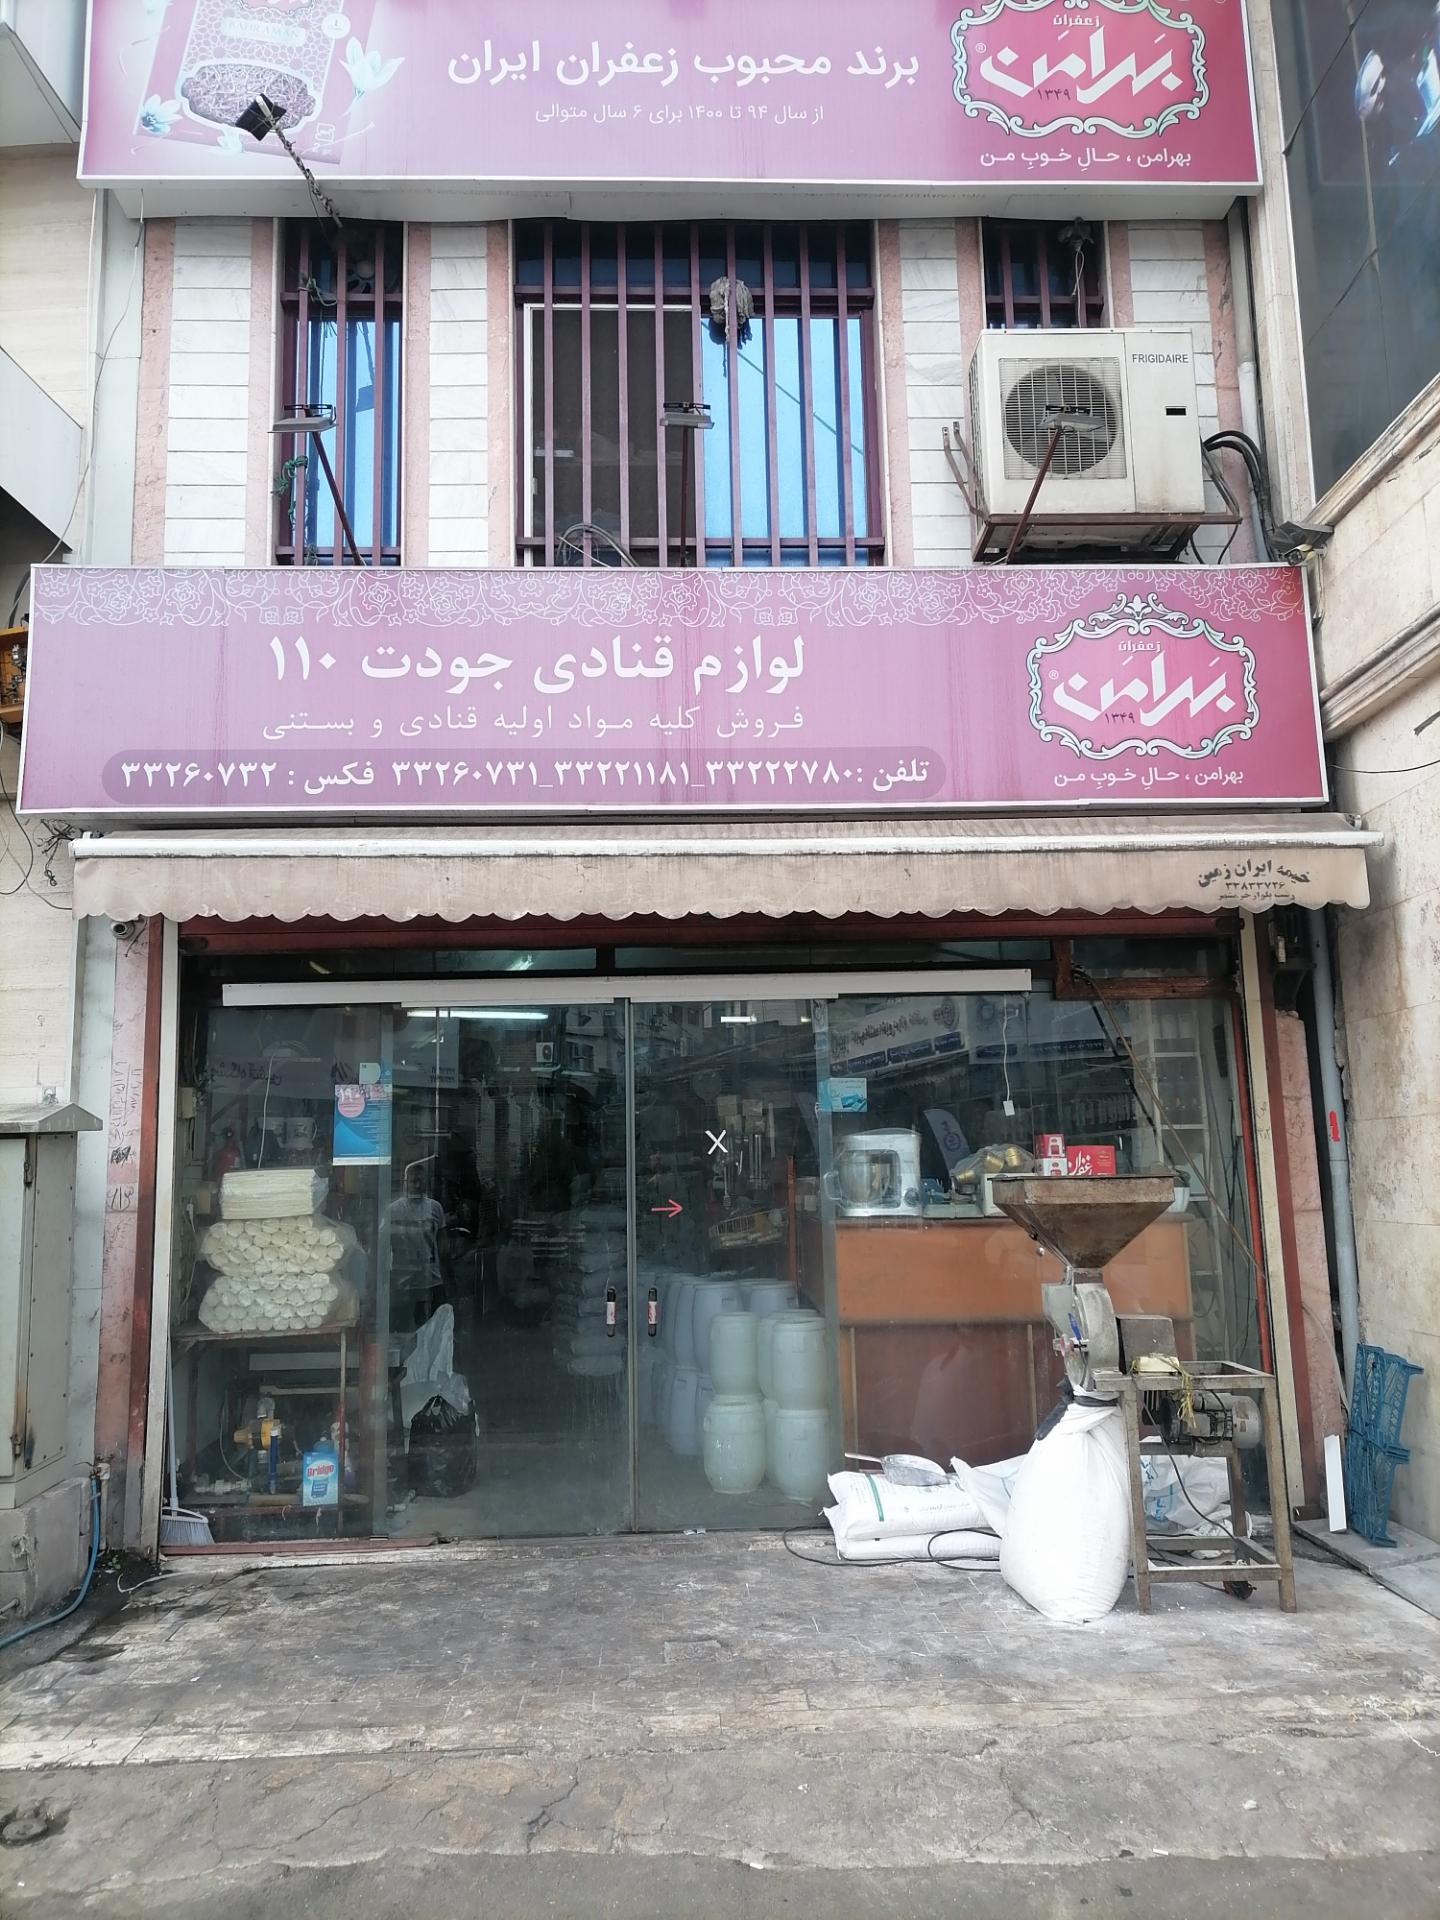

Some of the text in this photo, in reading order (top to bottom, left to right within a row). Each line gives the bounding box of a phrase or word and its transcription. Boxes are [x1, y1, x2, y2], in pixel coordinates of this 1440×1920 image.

[1053, 14, 1100, 27] زعفران
[447, 40, 919, 89] برند محبوب زعفران ایران
[535, 104, 587, 122] متوالی
[593, 104, 627, 123] سال
[648, 104, 682, 124] برای
[688, 105, 723, 120] ۱۴۰۰
[729, 105, 742, 120] تا
[747, 105, 768, 119] ۹۴
[773, 105, 807, 125] سال
[811, 105, 824, 125] از
[980, 151, 1016, 167] من
[1137, 148, 1191, 168] بهرامن
[1132, 353, 1189, 364] FRIGIDAIRE
[1118, 639, 1162, 653] زعفران
[270, 634, 804, 696] لوازم قنادی جودت ۱۱۰
[262, 704, 804, 741] فروش کلیه مواد اولیه قنادی و بستنی
[120, 761, 277, 788] ۳۳۲۶۰۷۳۲
[303, 761, 375, 795] فکس
[872, 758, 931, 792] تلفن
[1053, 772, 1086, 788] من
[1194, 766, 1244, 786] بهرامن
[1198, 863, 1232, 887] زمین
[1234, 859, 1272, 877] ایران
